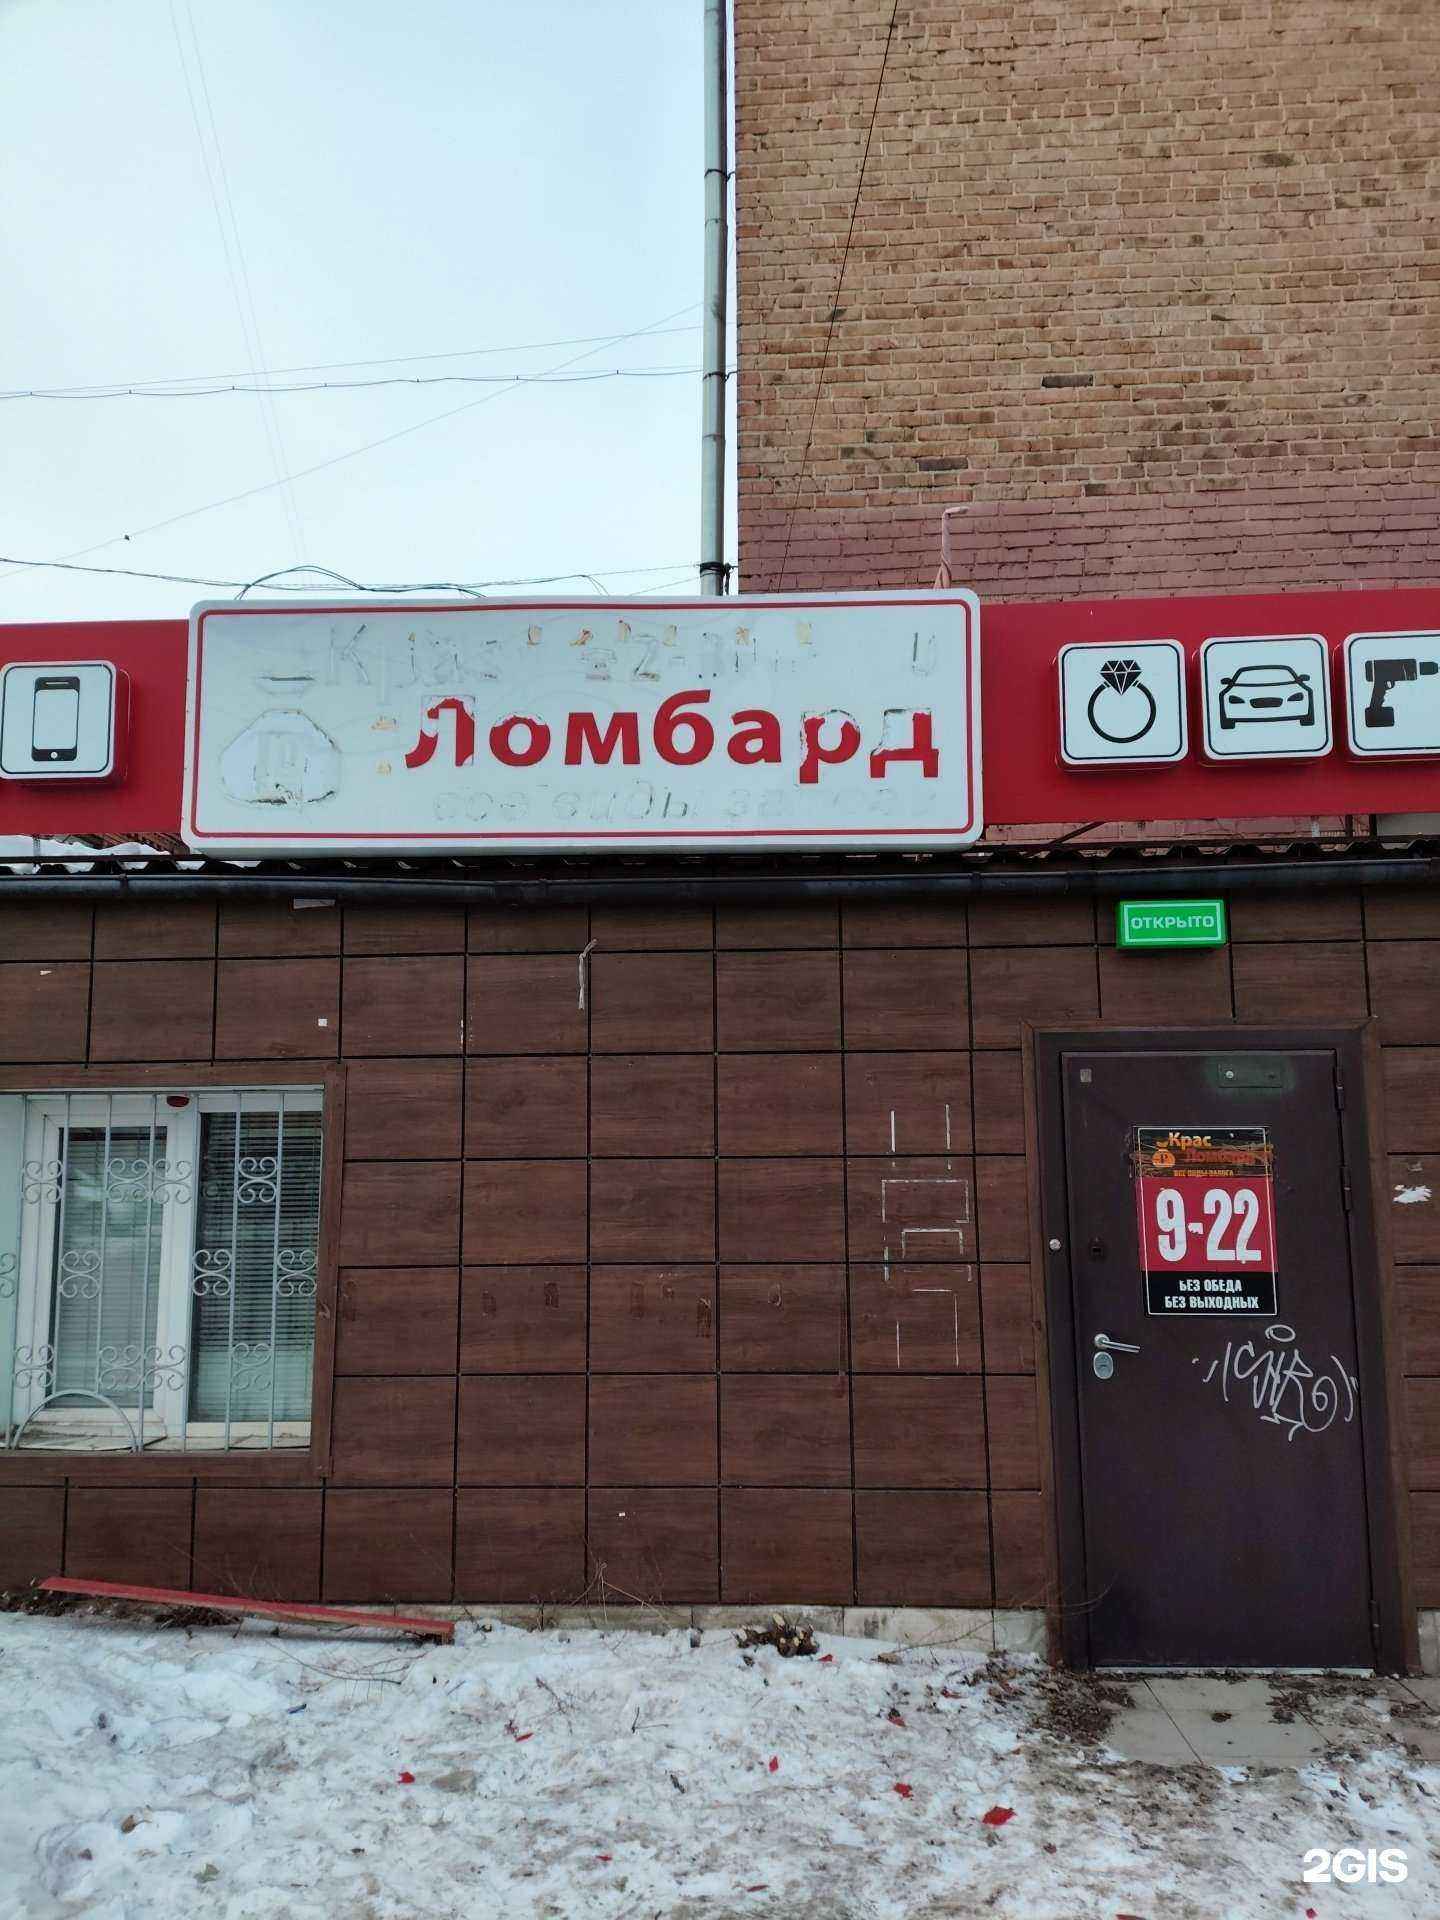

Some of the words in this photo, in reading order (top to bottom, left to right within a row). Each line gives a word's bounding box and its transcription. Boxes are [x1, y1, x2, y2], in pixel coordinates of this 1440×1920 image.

[406, 690, 940, 784] Ломбард
[1131, 915, 1215, 929] ОТКРЫТО
[1168, 1132, 1211, 1149] Крас
[1156, 1188, 1262, 1262] 9-22
[1179, 1279, 1201, 1292] БЕЗ
[1204, 1279, 1242, 1292] ОБЕДА
[1165, 1297, 1186, 1309] БЕЗ
[1189, 1296, 1259, 1310] ВЫХОДНЫХ
